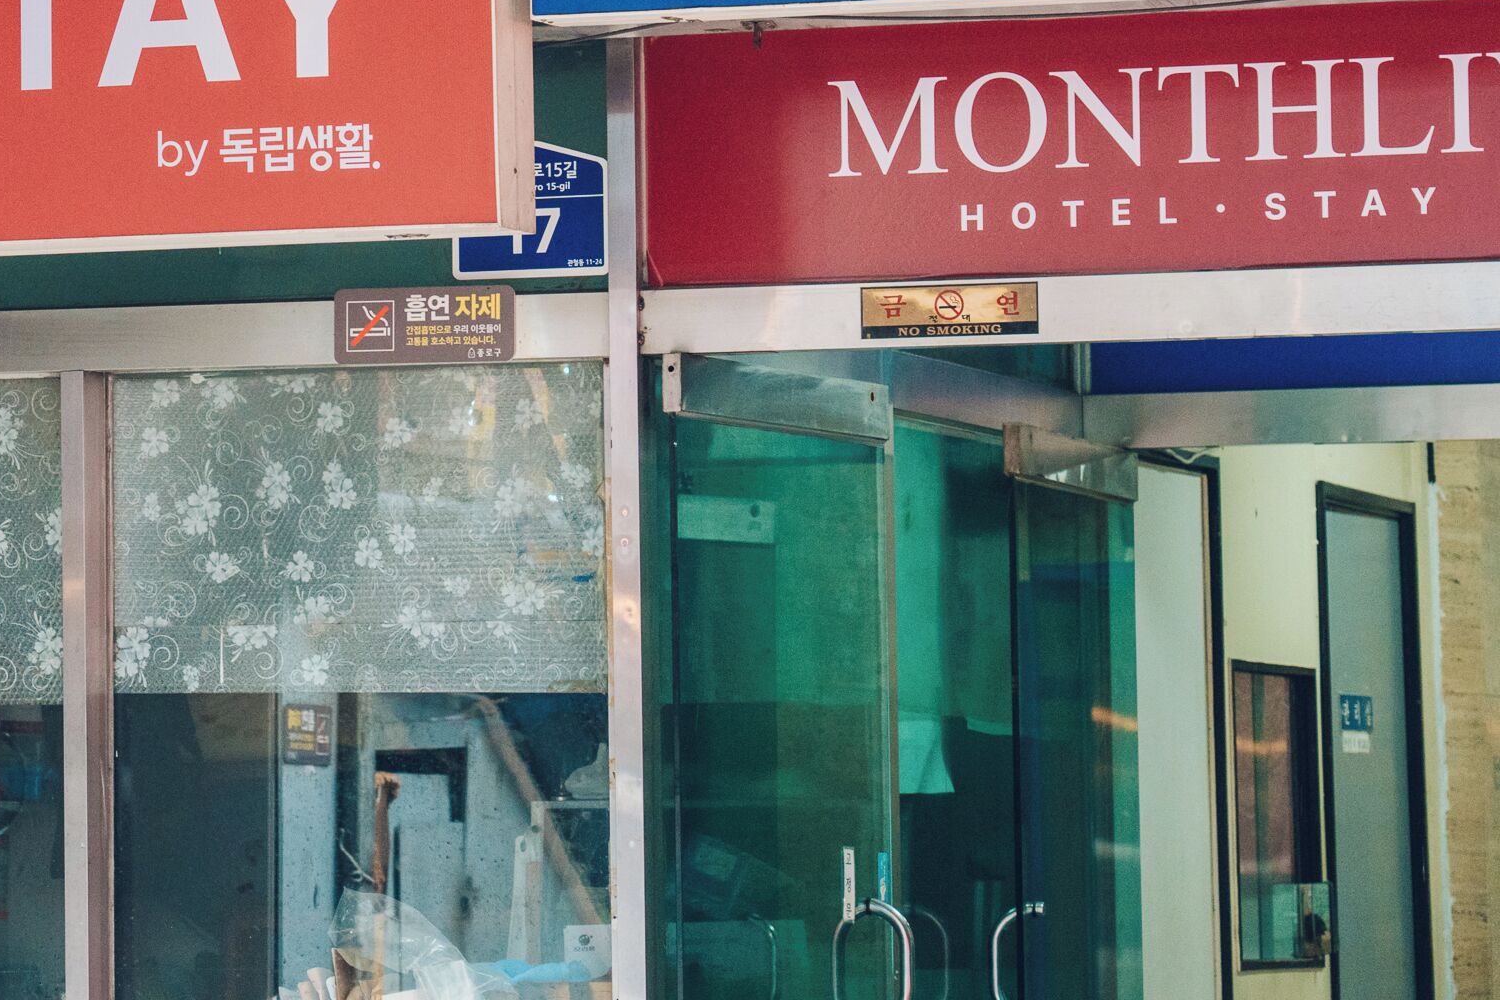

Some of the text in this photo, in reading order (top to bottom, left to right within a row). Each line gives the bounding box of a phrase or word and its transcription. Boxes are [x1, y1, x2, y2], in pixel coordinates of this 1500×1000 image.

[827, 51, 1500, 177] MONTHLI
[157, 130, 209, 177] by
[534, 160, 578, 179] 로15길
[546, 182, 571, 192] 15-gil
[586, 258, 603, 266] 11-24
[404, 293, 501, 322] 흡연 자제
[880, 291, 1020, 319] 금 연
[405, 323, 502, 335] 간접흡연으로 우리 이웃들이
[898, 324, 1003, 337] NO SMOKING
[405, 335, 497, 346] 고통을 호소하고 있습니다.
[476, 347, 502, 358] 종로구
